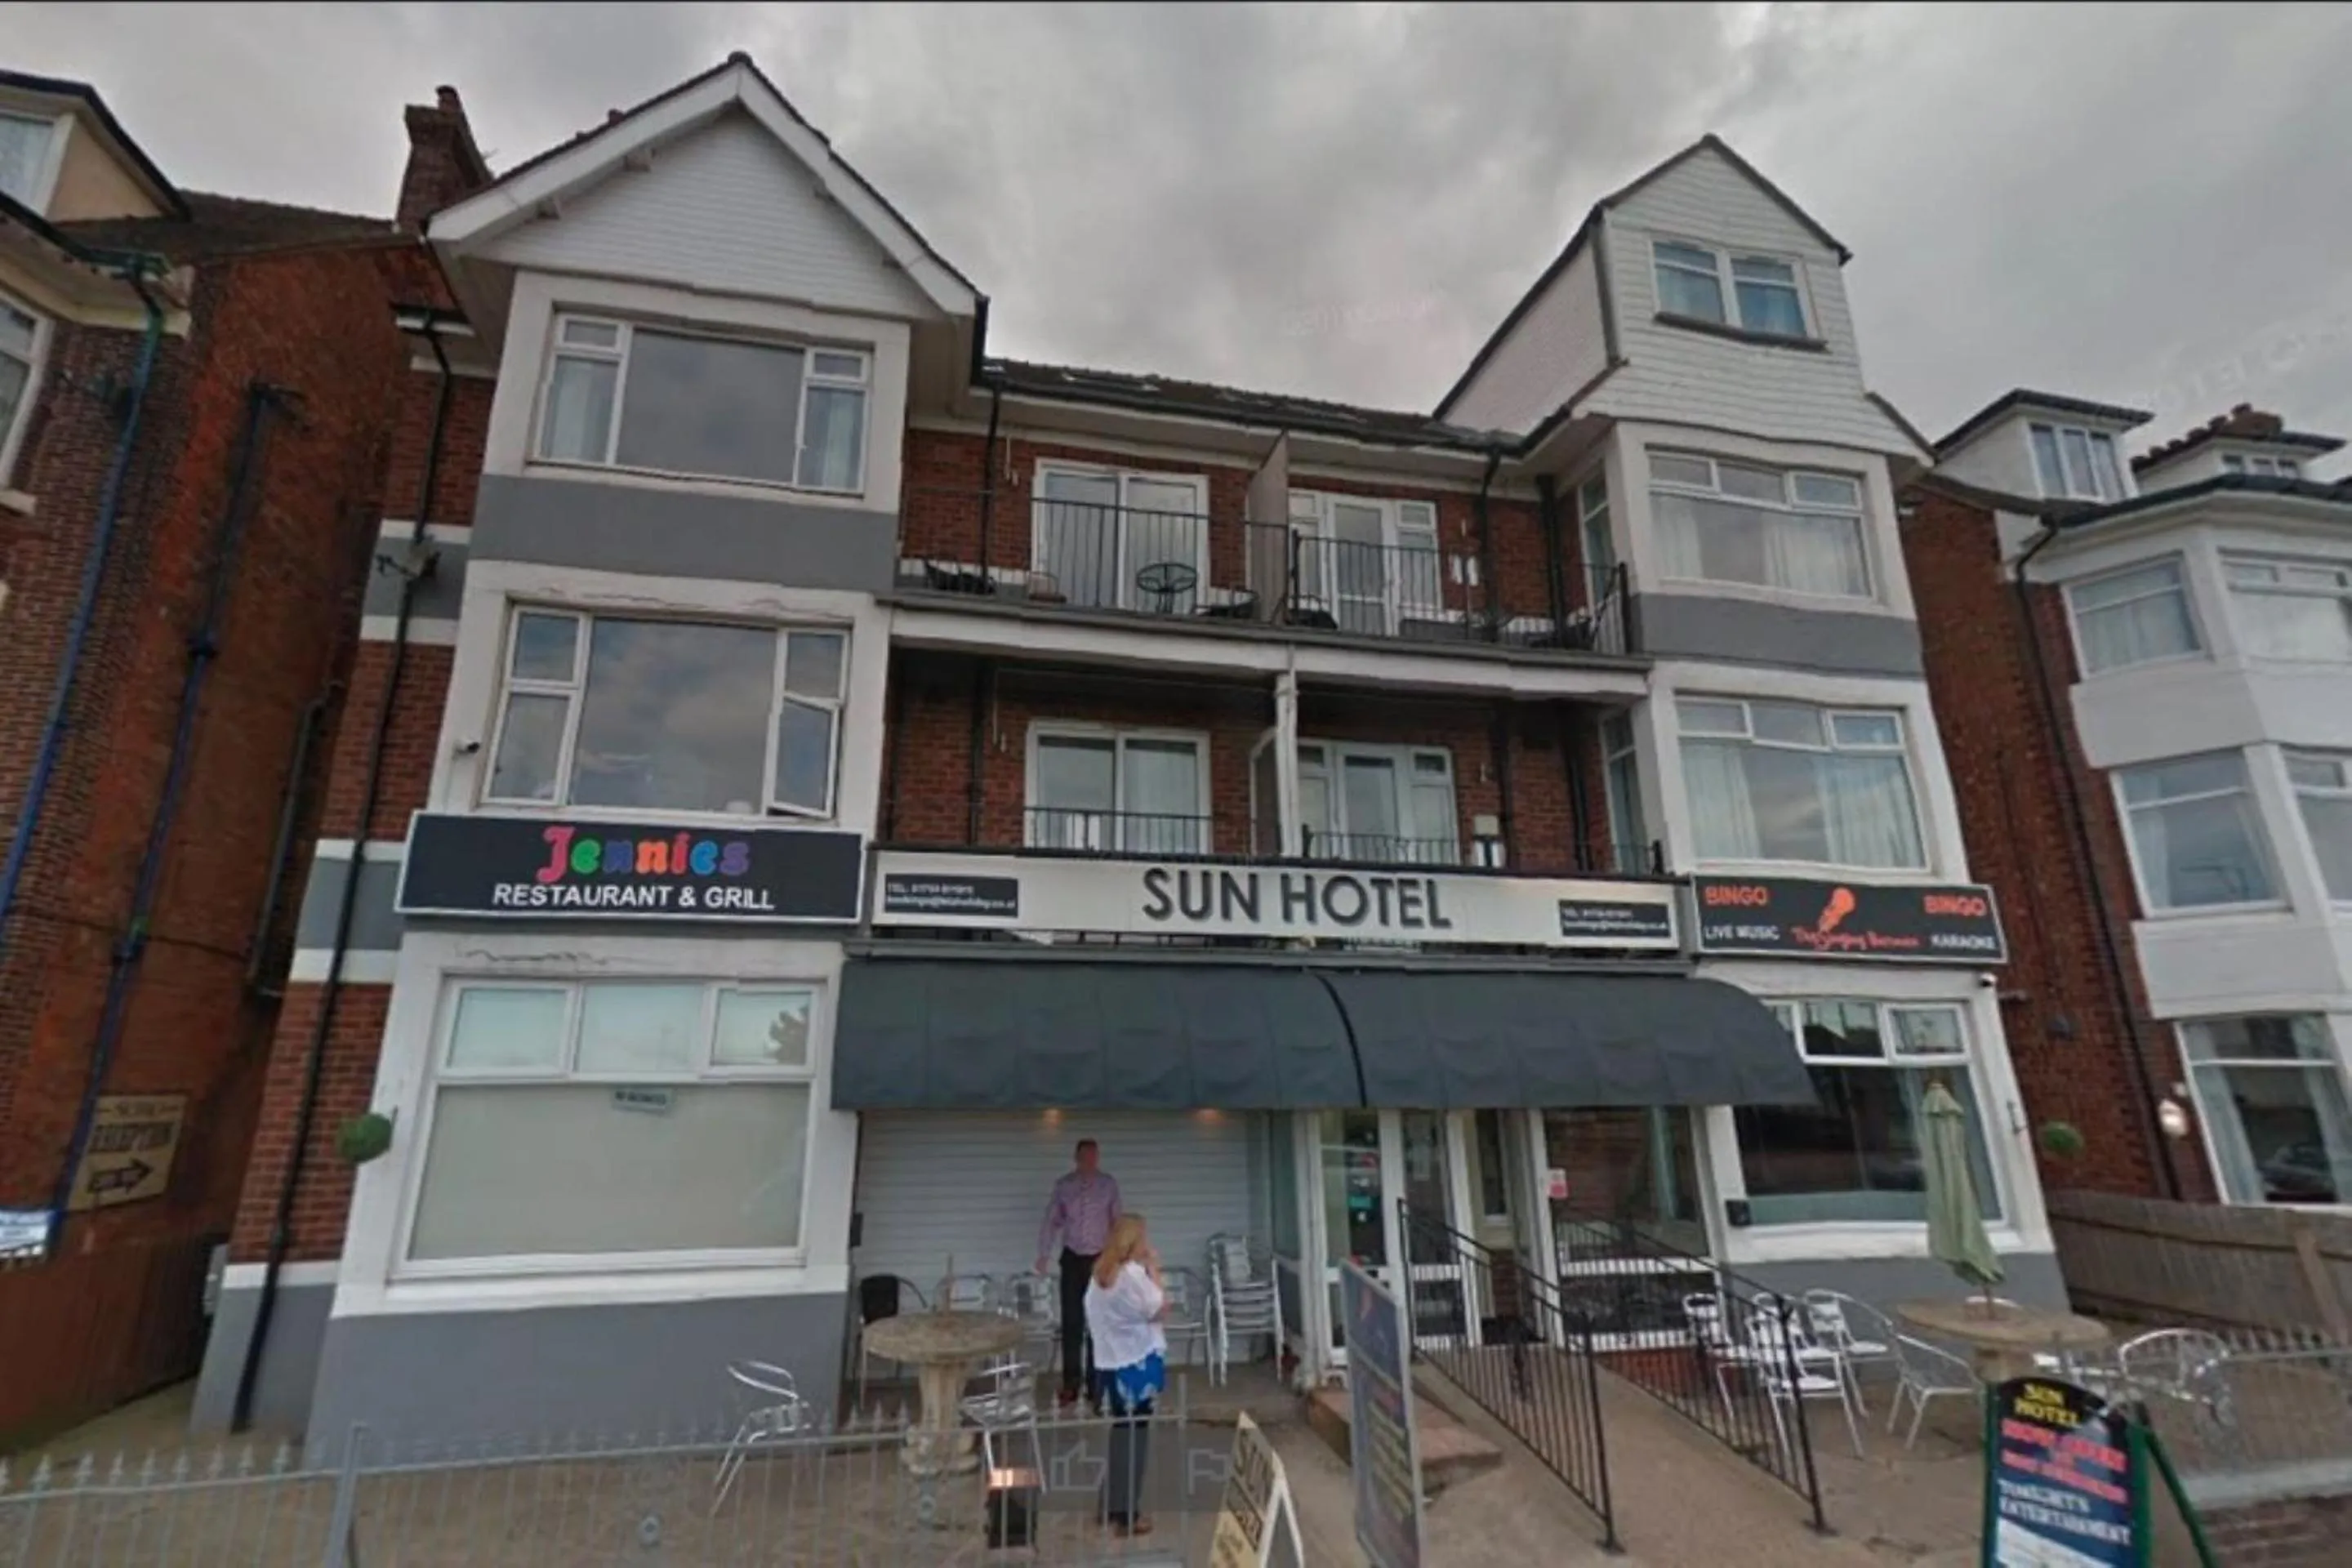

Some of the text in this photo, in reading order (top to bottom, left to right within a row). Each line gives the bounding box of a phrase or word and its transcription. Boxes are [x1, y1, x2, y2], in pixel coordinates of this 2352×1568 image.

[536, 825, 751, 884] Jennies
[492, 883, 775, 911] RESTAURANT & GRILL
[1143, 866, 1452, 929] SUN HOTEL
[1704, 885, 1768, 906] BINGO
[1923, 894, 1988, 916] BINGO
[1704, 924, 1780, 941] LIVE MUSIC
[1931, 934, 1996, 950] KARAOKE
[2014, 1397, 2079, 1426] HOTEL
